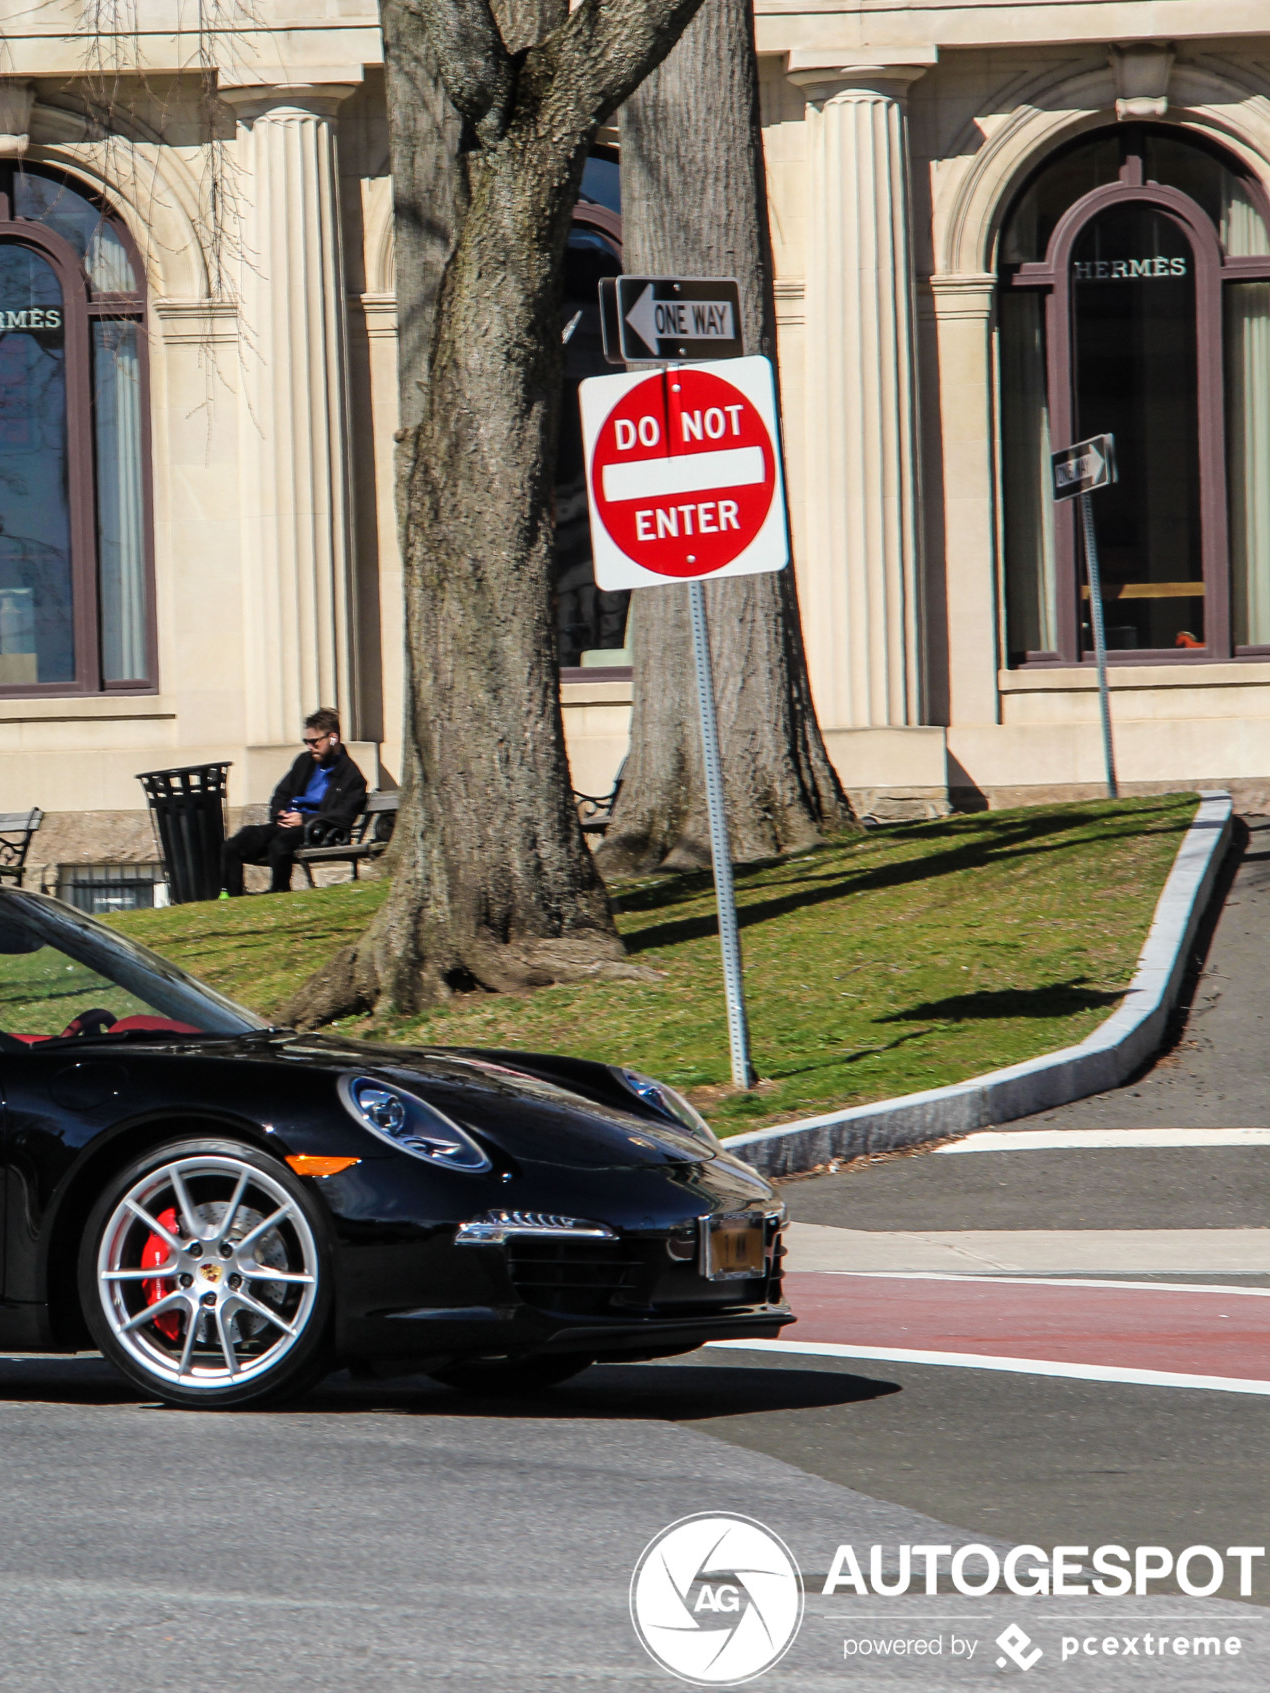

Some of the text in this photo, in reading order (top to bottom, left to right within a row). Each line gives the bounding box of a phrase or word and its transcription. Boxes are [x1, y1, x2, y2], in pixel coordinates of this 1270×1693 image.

[654, 304, 728, 335] ONE WAY
[614, 404, 744, 450] DO NOT
[635, 500, 740, 541] ENTER
